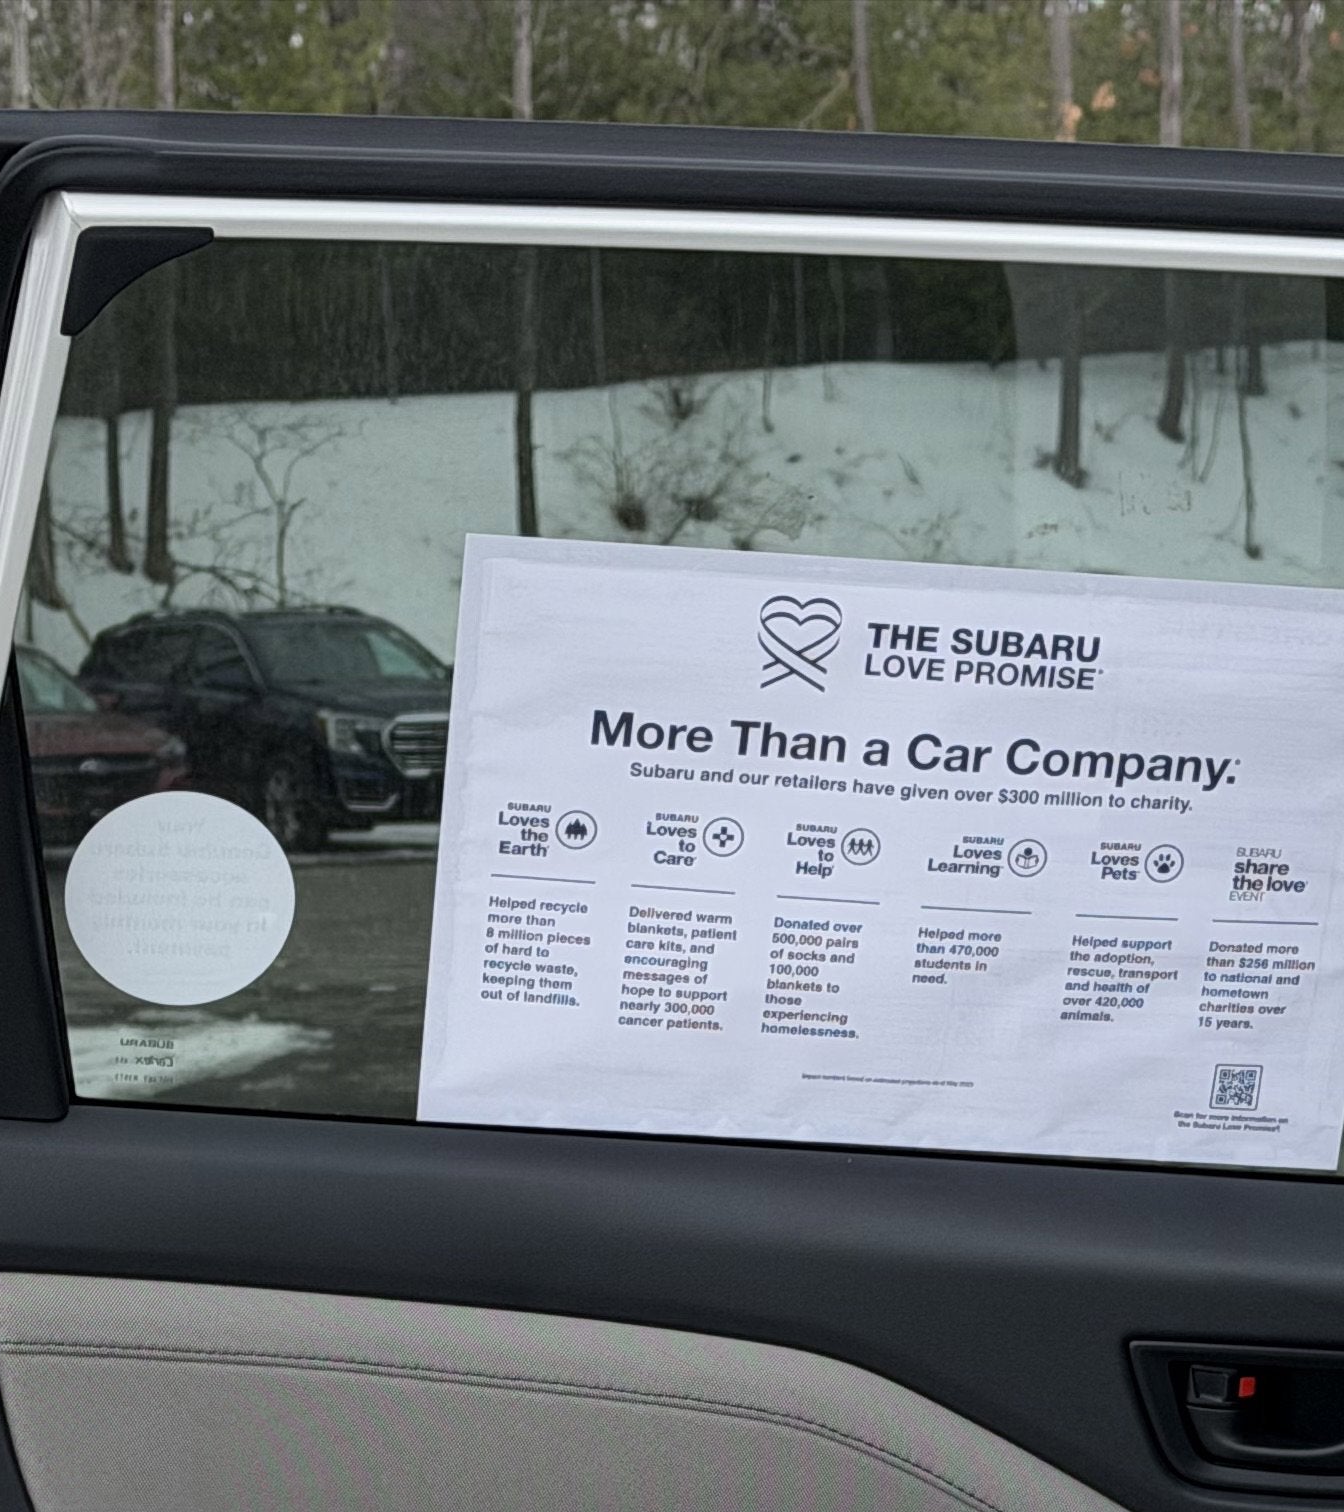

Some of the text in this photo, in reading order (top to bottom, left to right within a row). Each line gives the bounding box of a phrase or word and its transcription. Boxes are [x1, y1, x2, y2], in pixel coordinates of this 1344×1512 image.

[868, 623, 1100, 663] THE SUBARU
[865, 653, 1096, 690] LOVE PROMISE
[591, 710, 1235, 791] More Than a Car Company.
[630, 762, 1192, 814] Subaru and our retailers have given over $300 million to charity.
[507, 802, 552, 813] SUBARU
[498, 811, 550, 828] Loves
[655, 812, 699, 823] SUBARU
[520, 828, 548, 842] the
[646, 821, 697, 838] Loves
[796, 823, 838, 834] SUBARU
[678, 839, 696, 853] to
[787, 832, 836, 848] Loves
[962, 836, 1005, 846] SUBARU
[1100, 842, 1142, 851] SUBARU
[499, 840, 547, 857] Earth
[818, 849, 834, 862] to
[953, 845, 1002, 860] Loves
[1236, 847, 1282, 859] SUBARU
[654, 850, 697, 866] Care
[1091, 851, 1139, 866] Loves
[796, 861, 834, 879] Help
[928, 858, 1001, 878] Learning
[1101, 866, 1140, 880] Pets
[1234, 858, 1290, 876] share
[1232, 875, 1306, 893] the love
[1229, 891, 1264, 901] EVENT
[489, 896, 588, 915] Helped recycle
[487, 913, 556, 927] more than
[629, 906, 732, 925] Delivered warm
[627, 922, 737, 941] blankets, patient
[774, 916, 863, 933] Donated over
[486, 927, 591, 945] 8 million pieces
[772, 933, 859, 950] 500,000 pairs
[918, 927, 1002, 942] Helped more
[485, 942, 550, 958] of hard to
[625, 940, 715, 954] care kits, and
[916, 943, 999, 957] than 470,000
[1072, 935, 1172, 952] Helped support
[1209, 941, 1299, 955] Donated more
[624, 955, 708, 972] encouraging
[770, 948, 855, 964] of socks and
[1070, 951, 1155, 966] the adoption,
[1206, 956, 1315, 971] than $256 million
[483, 960, 578, 977] recycle waste,
[769, 964, 819, 977] 100,000
[914, 958, 987, 972] students in
[482, 972, 572, 990] keeping them
[623, 971, 708, 985] messages of
[912, 973, 947, 984] need.
[1067, 967, 1178, 981] rescue, transport
[1204, 971, 1300, 986] to national and
[621, 984, 728, 1002] hope to support
[766, 978, 840, 994] blankets to
[1065, 981, 1150, 993] and health of
[1201, 985, 1269, 999] hometown
[481, 990, 580, 1006] out of landfills.
[765, 994, 802, 1006] those
[1063, 996, 1144, 1009] over 420,000
[620, 1001, 715, 1015] nearly 300,000
[1199, 1001, 1287, 1015] charities over
[618, 1016, 723, 1031] cancer patients.
[763, 1010, 848, 1026] experiencing
[1060, 1010, 1114, 1022] animals.
[1198, 1016, 1253, 1030] 15 years.
[761, 1022, 859, 1039] homelessness.
